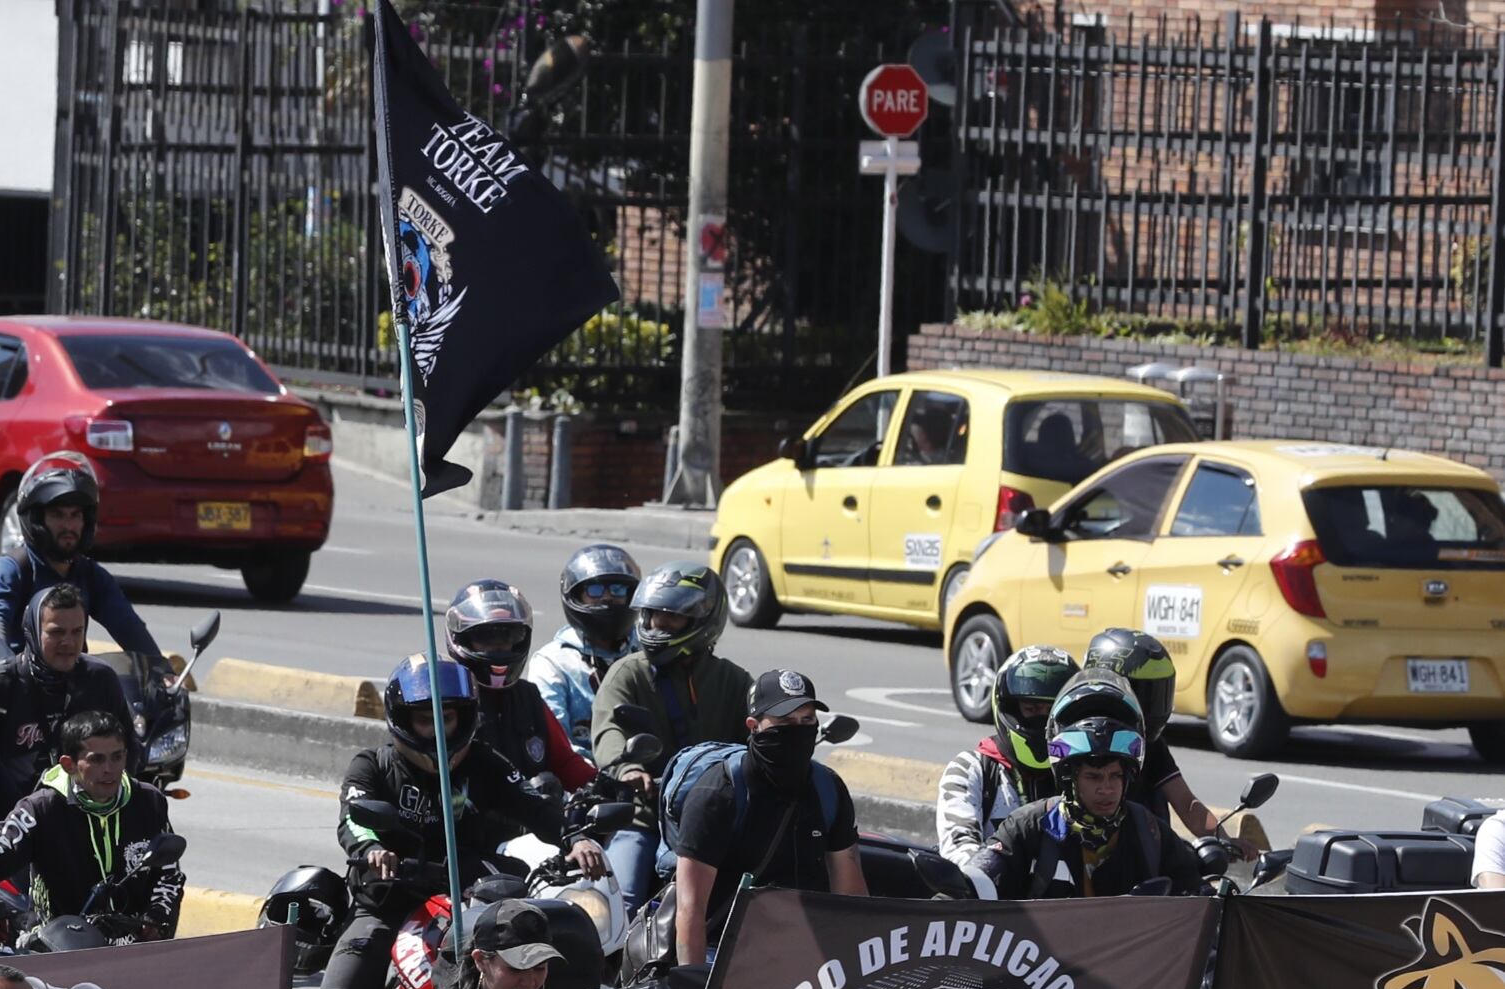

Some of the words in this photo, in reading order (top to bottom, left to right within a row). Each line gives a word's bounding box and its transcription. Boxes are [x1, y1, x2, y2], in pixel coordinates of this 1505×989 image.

[872, 89, 921, 112] PARE
[420, 123, 508, 214] TORKE
[448, 110, 530, 186] TEAM
[404, 193, 449, 244] TORKE
[1147, 595, 1175, 621] WGH
[1179, 597, 1200, 623] 841
[1409, 665, 1436, 682] WGH
[1440, 666, 1466, 684] 841
[857, 925, 910, 978] DE
